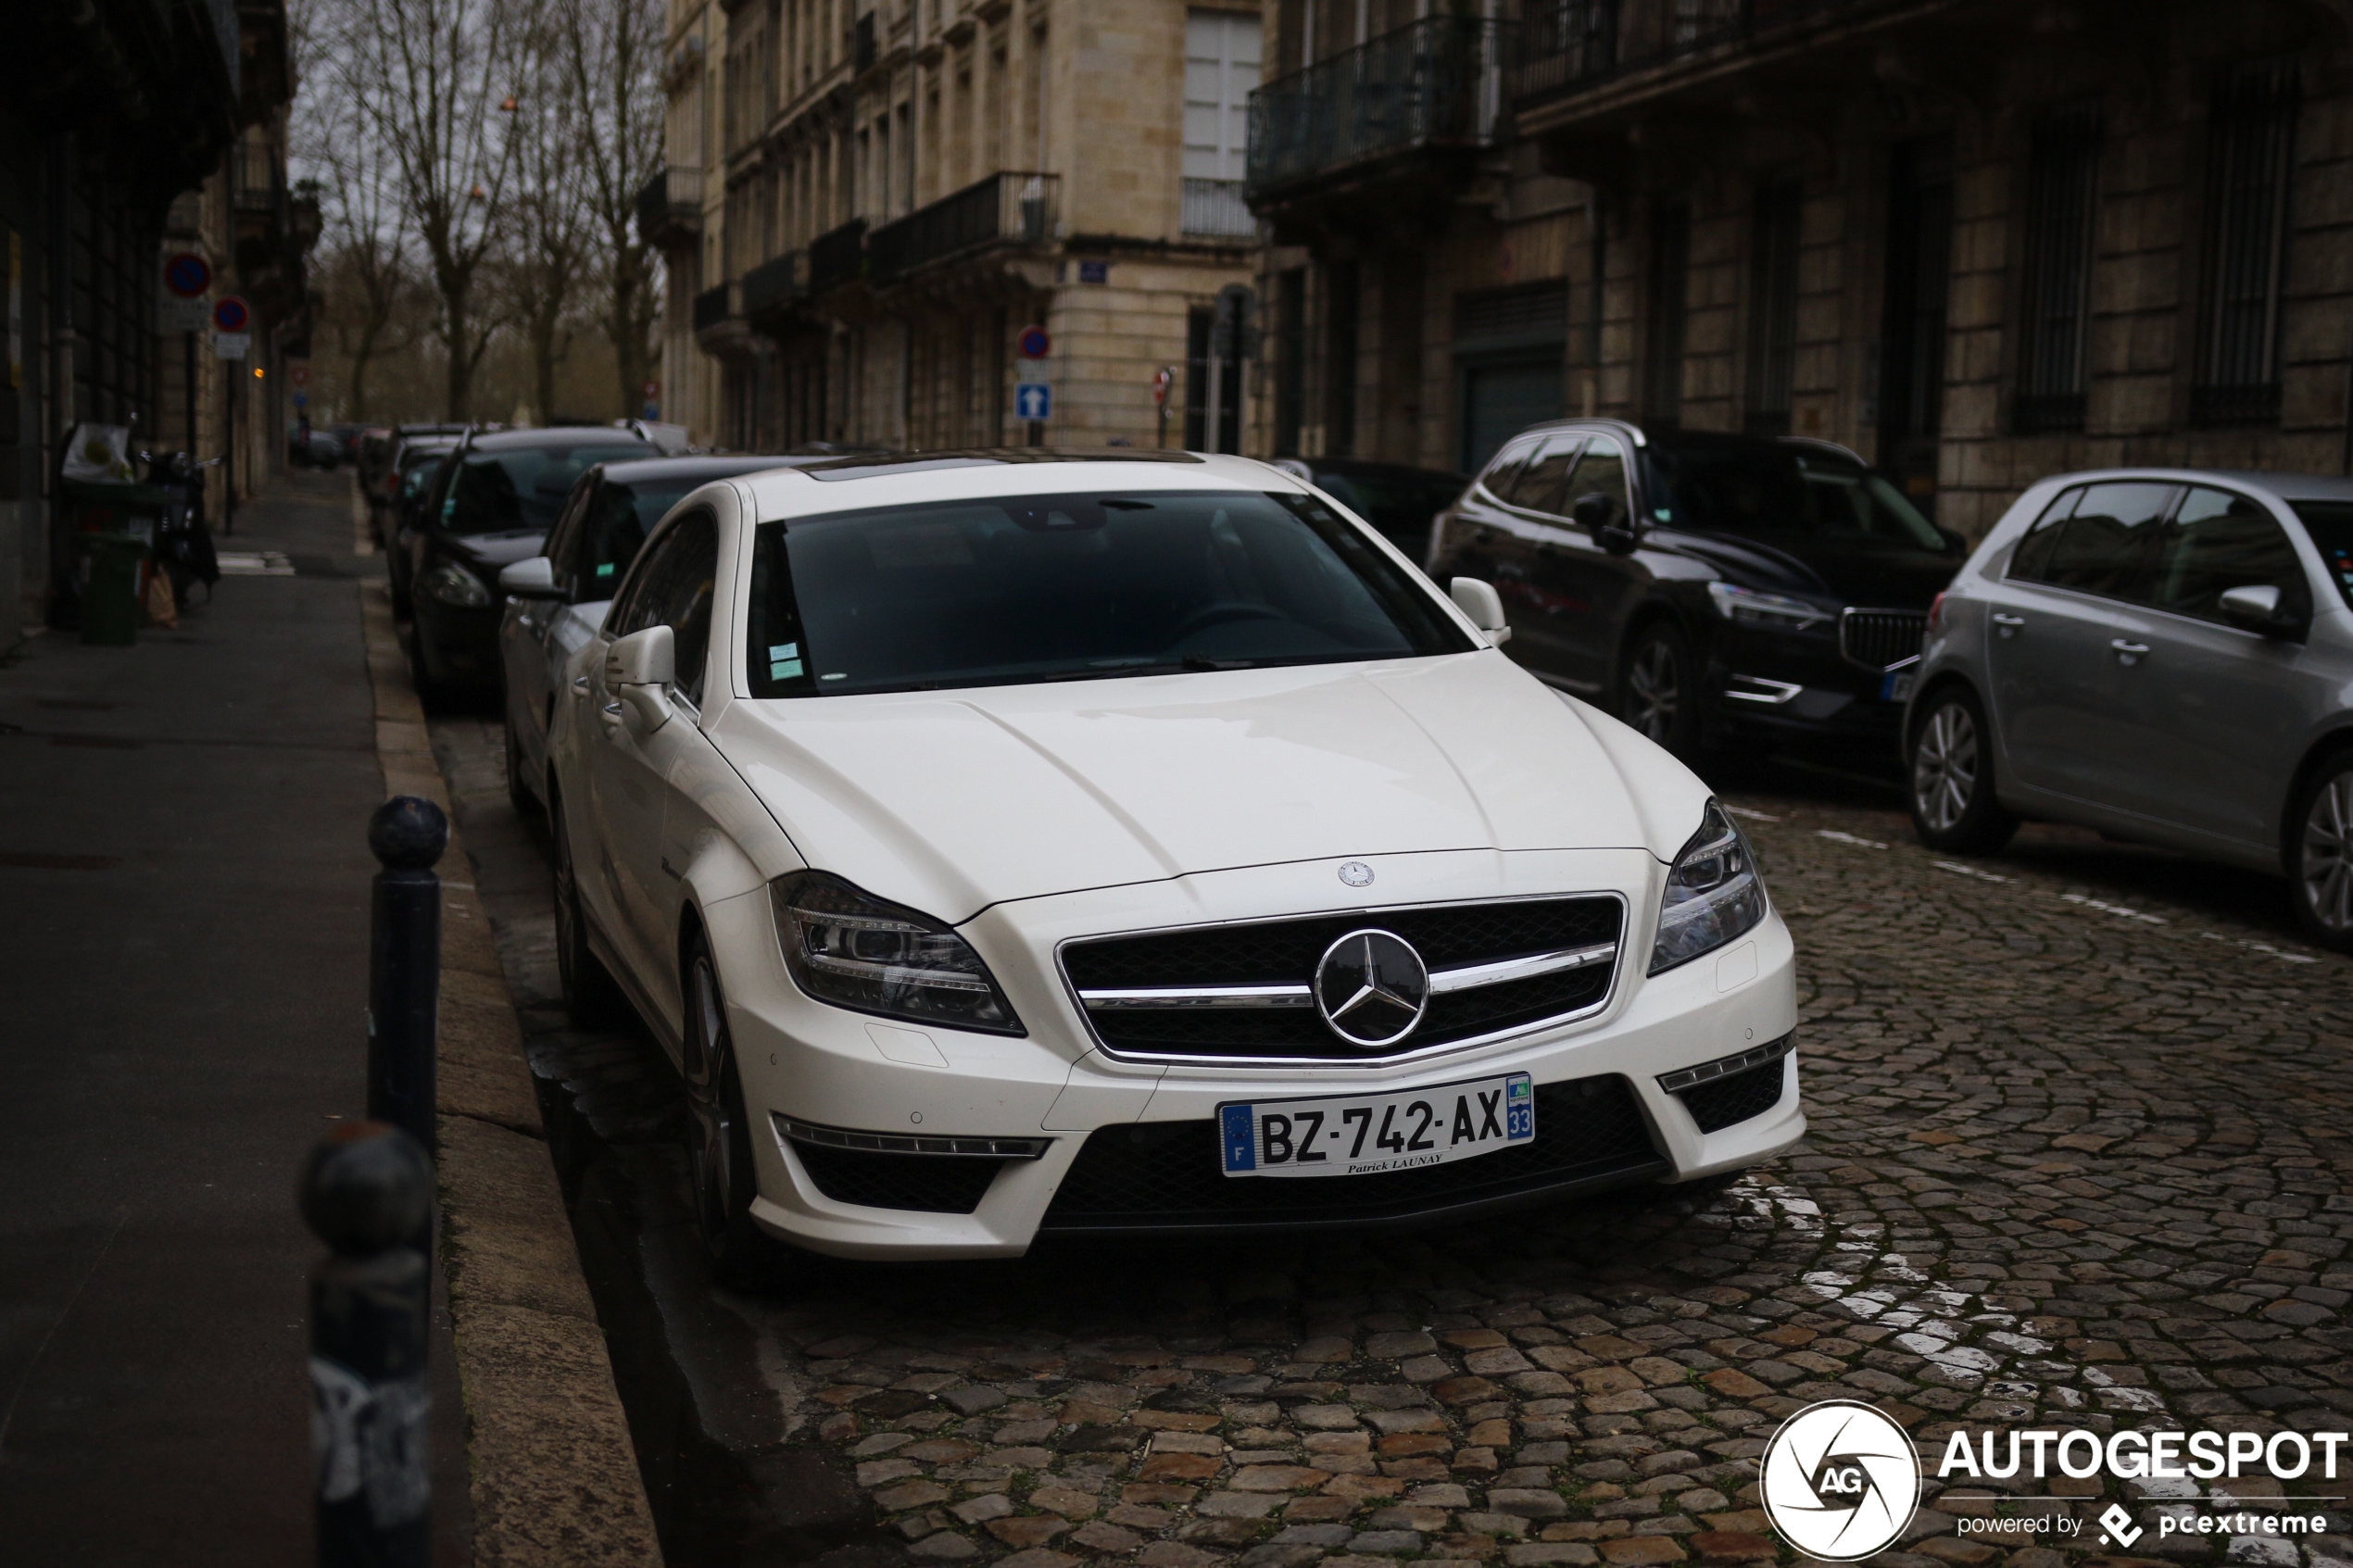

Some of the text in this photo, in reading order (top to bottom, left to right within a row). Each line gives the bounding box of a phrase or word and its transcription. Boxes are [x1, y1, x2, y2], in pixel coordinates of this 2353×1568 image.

[1262, 1089, 1503, 1164] BZ-742-AX
[1509, 1109, 1531, 1135] 33
[1234, 1146, 1242, 1161] F
[1348, 1154, 1443, 1174] Patrick LAUNAY
